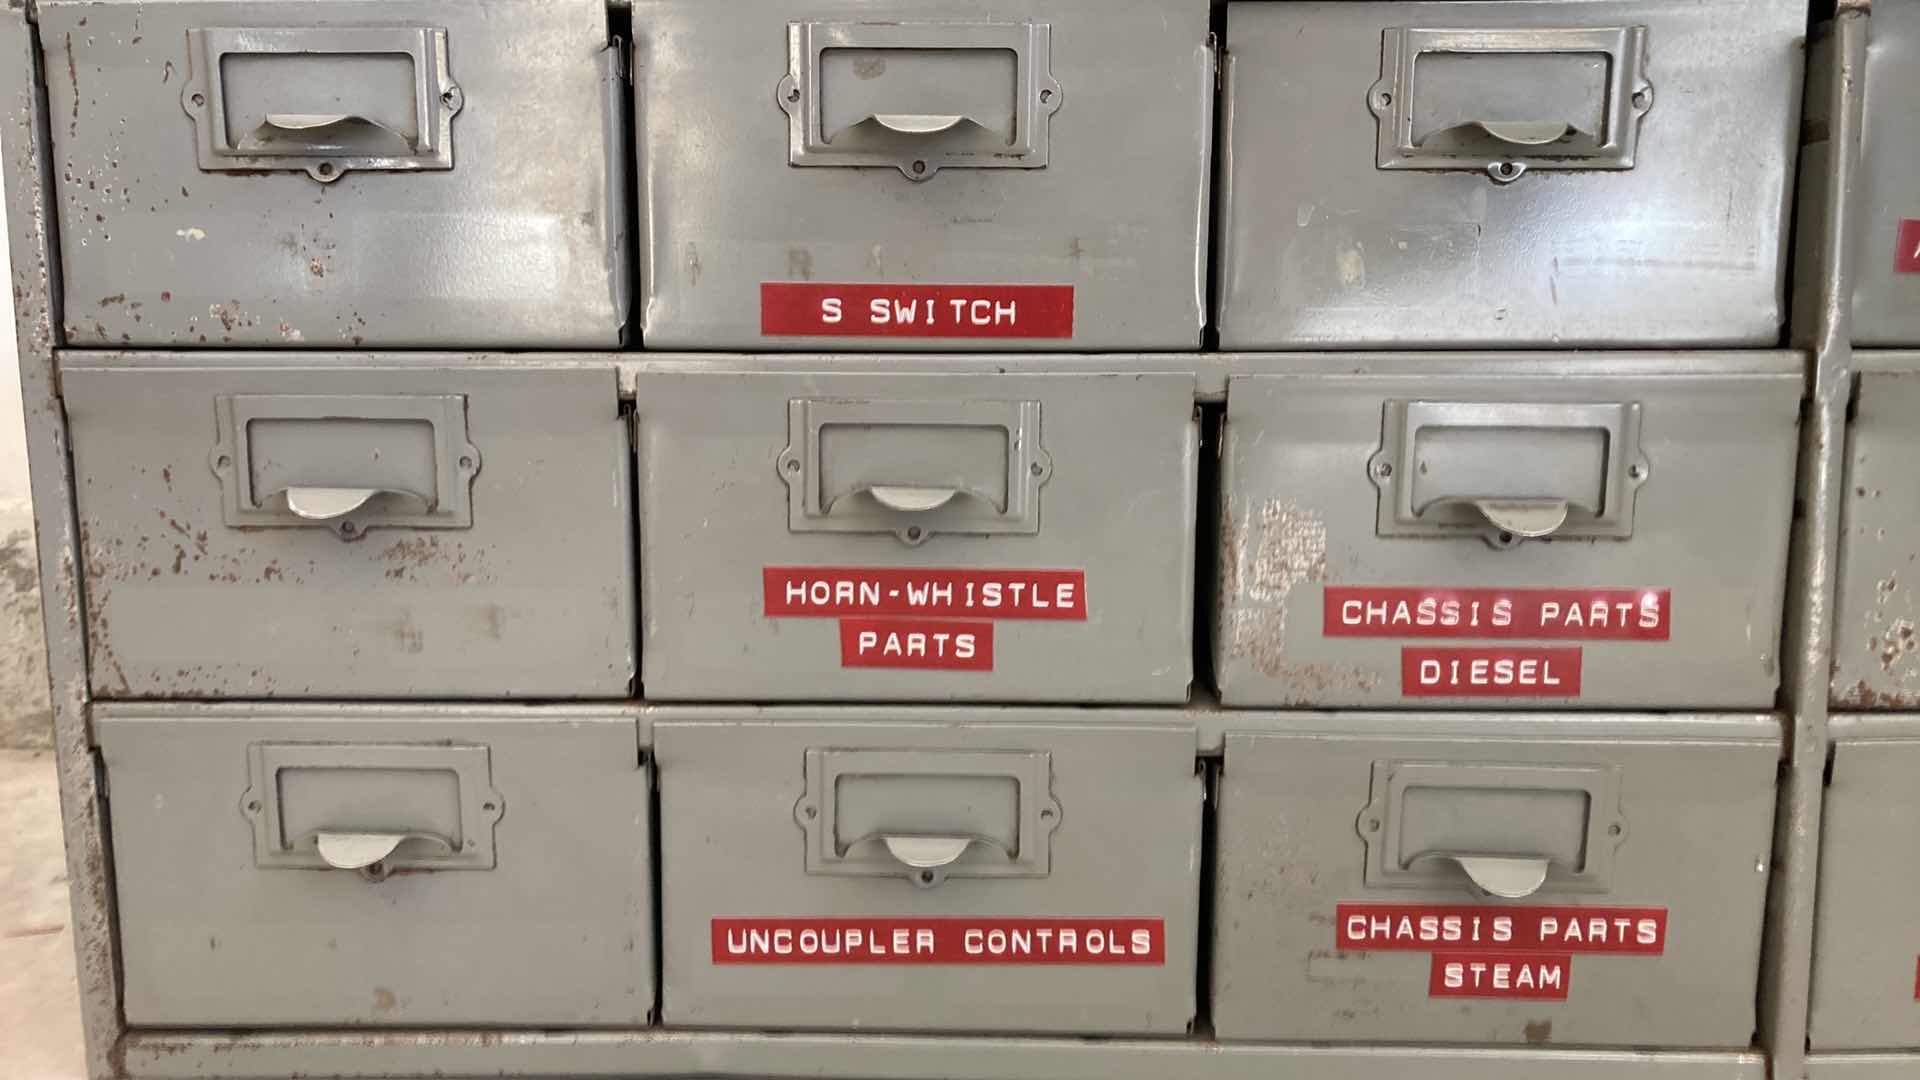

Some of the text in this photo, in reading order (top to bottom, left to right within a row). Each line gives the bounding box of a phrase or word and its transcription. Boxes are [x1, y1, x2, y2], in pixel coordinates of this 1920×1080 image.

[821, 297, 1017, 325] S SWITCH
[786, 580, 1075, 609] HORN-WHISTLE
[1341, 597, 1660, 629] CHASSIS PARTS
[858, 631, 976, 659] PARTS
[1420, 658, 1561, 686] DIESEL
[727, 928, 1151, 955] UNCOUPLER CONTROLS
[1347, 915, 1657, 944] CHASSIS PARTS
[1444, 962, 1561, 990] STEAM
